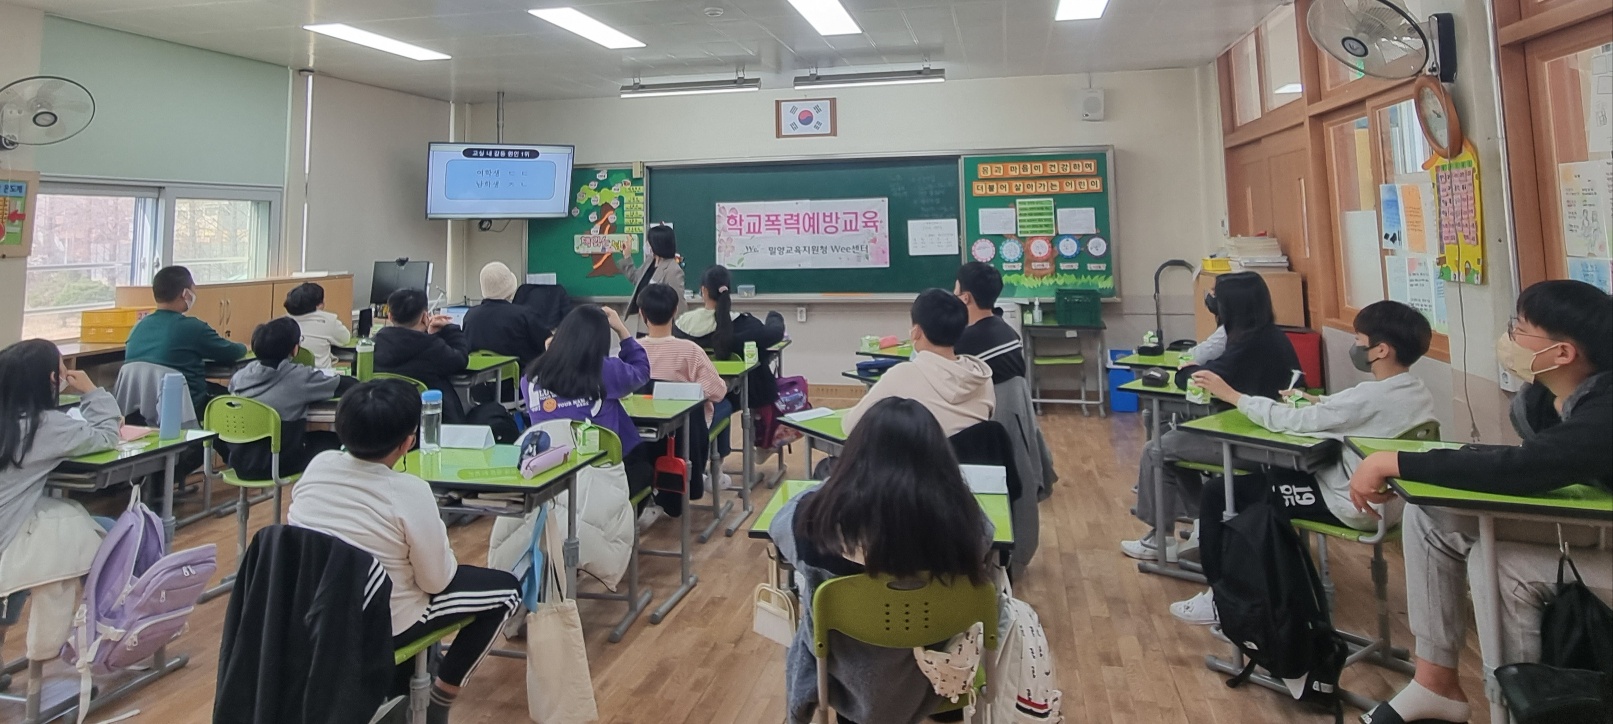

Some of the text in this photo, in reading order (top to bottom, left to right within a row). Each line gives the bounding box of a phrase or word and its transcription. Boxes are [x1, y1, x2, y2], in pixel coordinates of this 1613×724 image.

[1010, 163, 1043, 174] 마음이
[1049, 161, 1094, 174] 건강하여
[976, 178, 1099, 192] 더불어 살아가는 어린이
[727, 210, 880, 235] 학교폭력예방교육
[768, 244, 828, 256] 밀양교육지원청
[831, 243, 869, 255] Wee센터
[1292, 484, 1316, 506] 19
